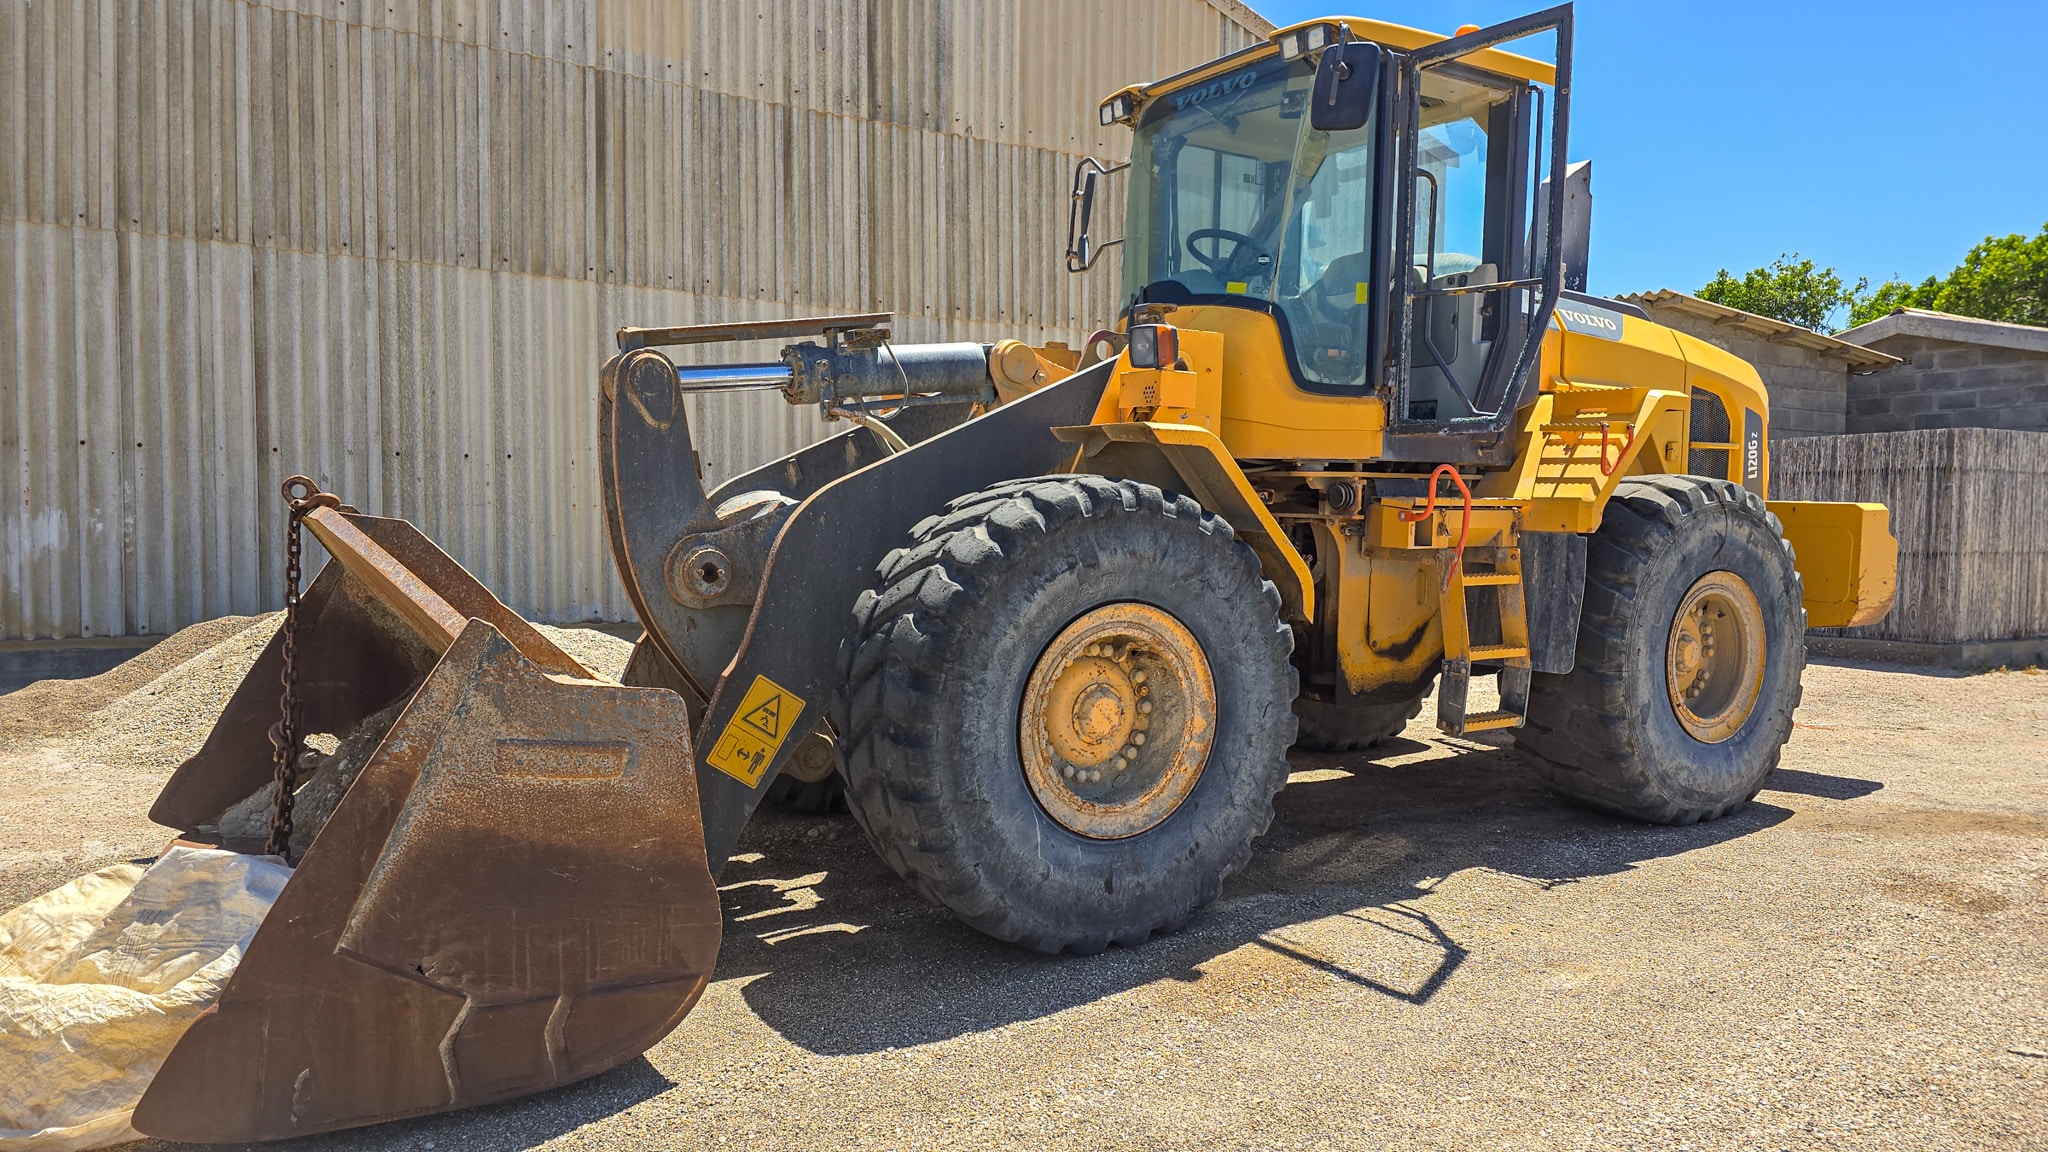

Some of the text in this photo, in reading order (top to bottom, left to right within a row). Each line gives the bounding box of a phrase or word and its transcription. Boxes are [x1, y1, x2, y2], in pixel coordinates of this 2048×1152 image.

[1175, 71, 1257, 111] VOLVO
[1558, 308, 1617, 331] VOLVO
[1747, 441, 1758, 479] L120G
